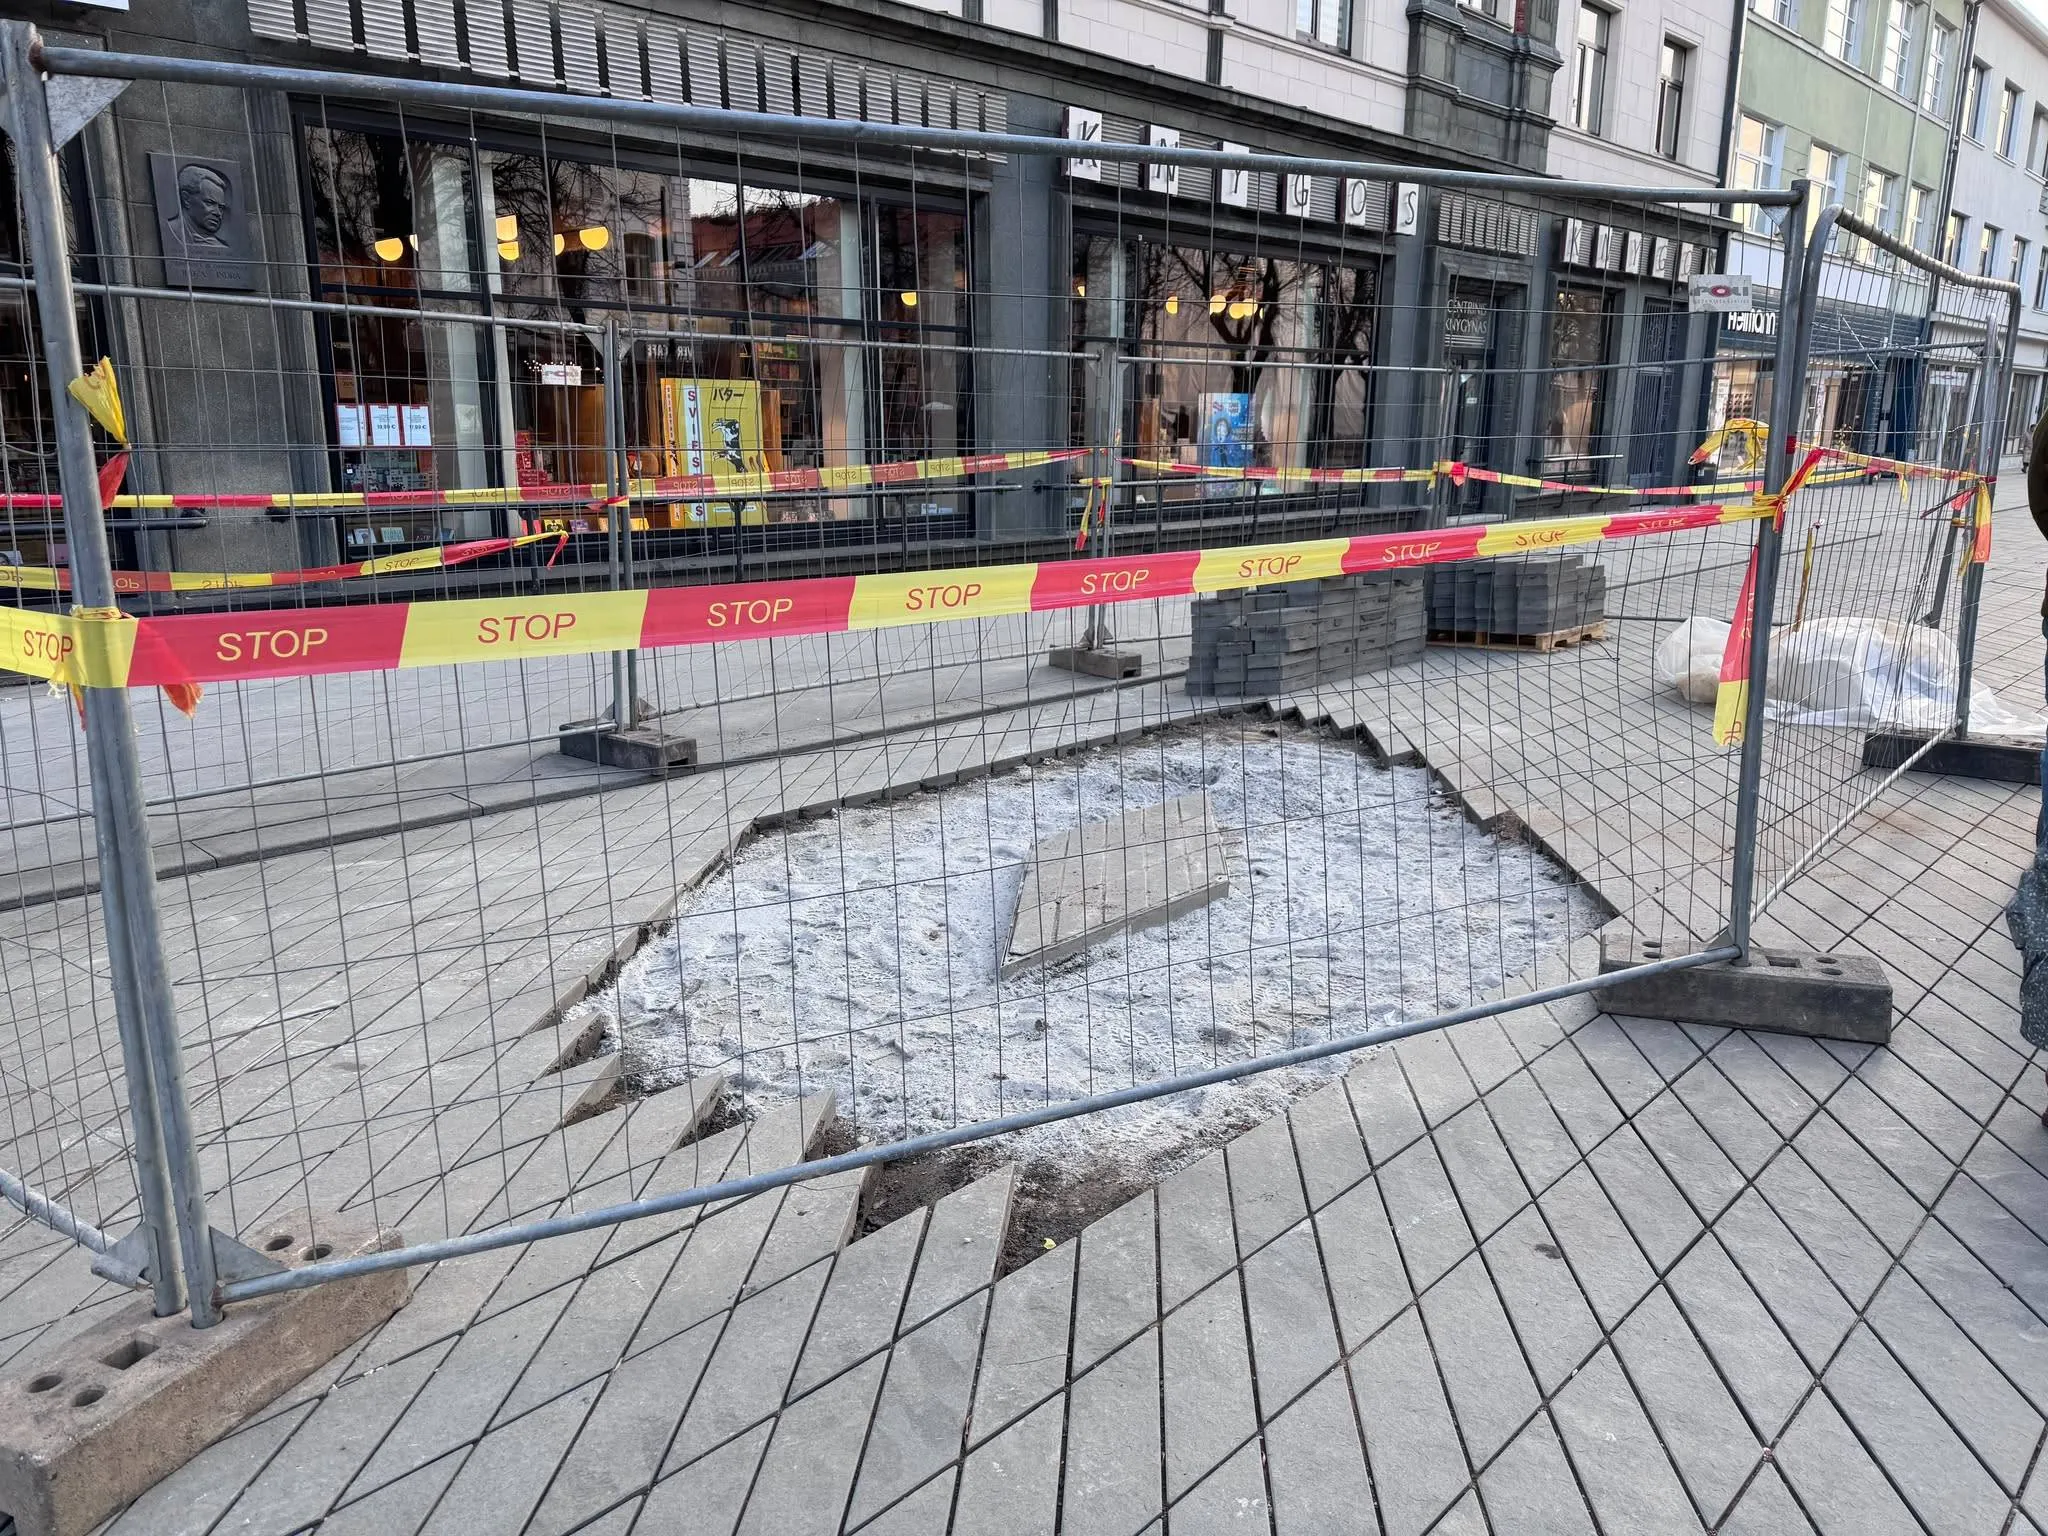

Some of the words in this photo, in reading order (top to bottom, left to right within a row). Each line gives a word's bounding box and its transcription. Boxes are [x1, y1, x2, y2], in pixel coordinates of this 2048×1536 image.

[1078, 120, 1417, 226] KNYGOS
[1445, 318, 1488, 333] KNYGYNAS
[713, 387, 745, 402] バター
[687, 390, 704, 516] SVIESS
[23, 629, 73, 663] STOP
[216, 628, 328, 662] STOP
[477, 613, 577, 644] STOP
[707, 598, 793, 627] STOP
[905, 584, 982, 610] STOP
[1081, 569, 1150, 595] STOP
[1238, 555, 1302, 578] STOP
[1382, 542, 1441, 563] STOP
